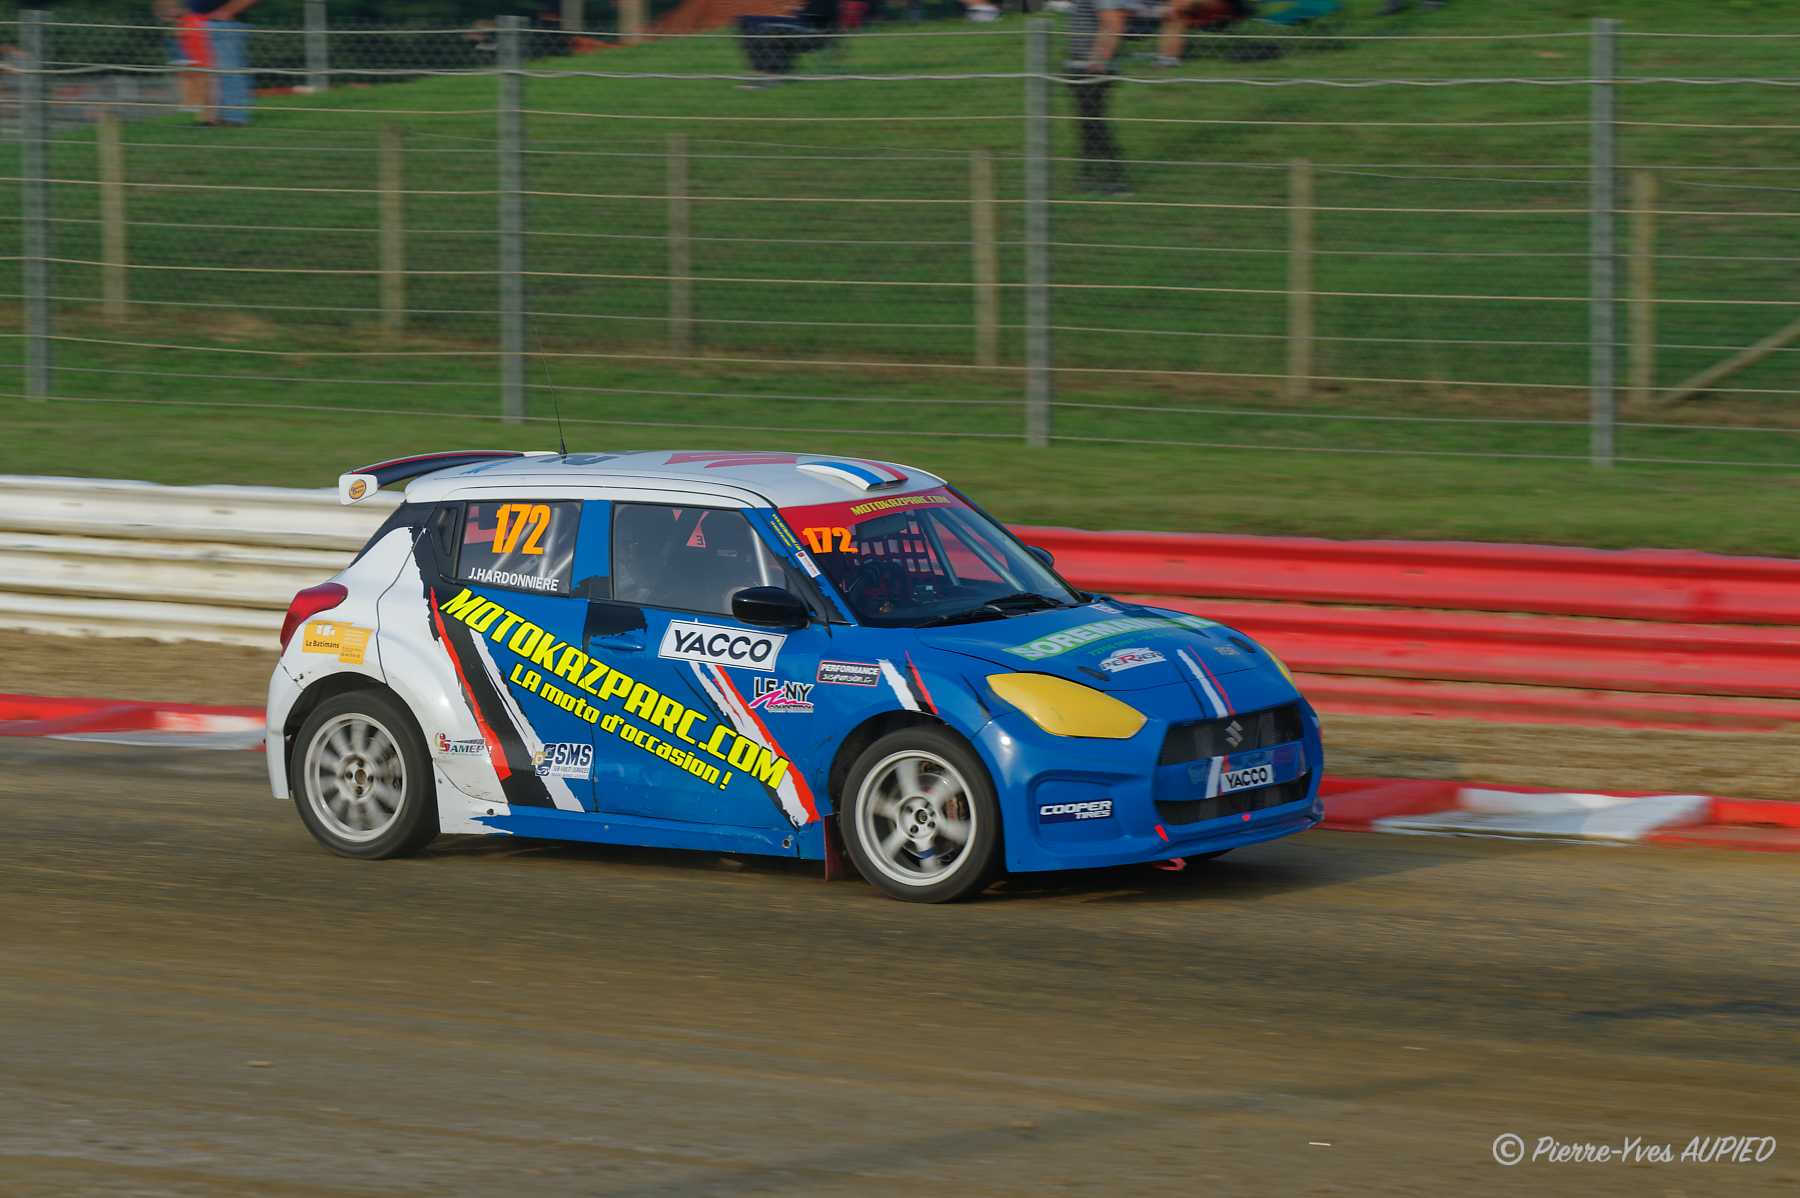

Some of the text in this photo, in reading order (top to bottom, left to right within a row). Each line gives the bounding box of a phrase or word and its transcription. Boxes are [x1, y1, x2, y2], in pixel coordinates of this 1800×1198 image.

[492, 503, 551, 555] 172
[801, 527, 858, 553] 172
[674, 629, 773, 663] YACCO
[821, 663, 879, 675] PERFORMANCE
[440, 587, 791, 790] MOTOKAZPARC.COM
[510, 662, 543, 693] LA
[539, 682, 601, 725] moto
[600, 714, 721, 785] d'occasion
[555, 743, 592, 767] SMS
[1225, 767, 1269, 788] YACCO
[1040, 800, 1112, 816] COOPER
[1074, 809, 1112, 819] TIRES
